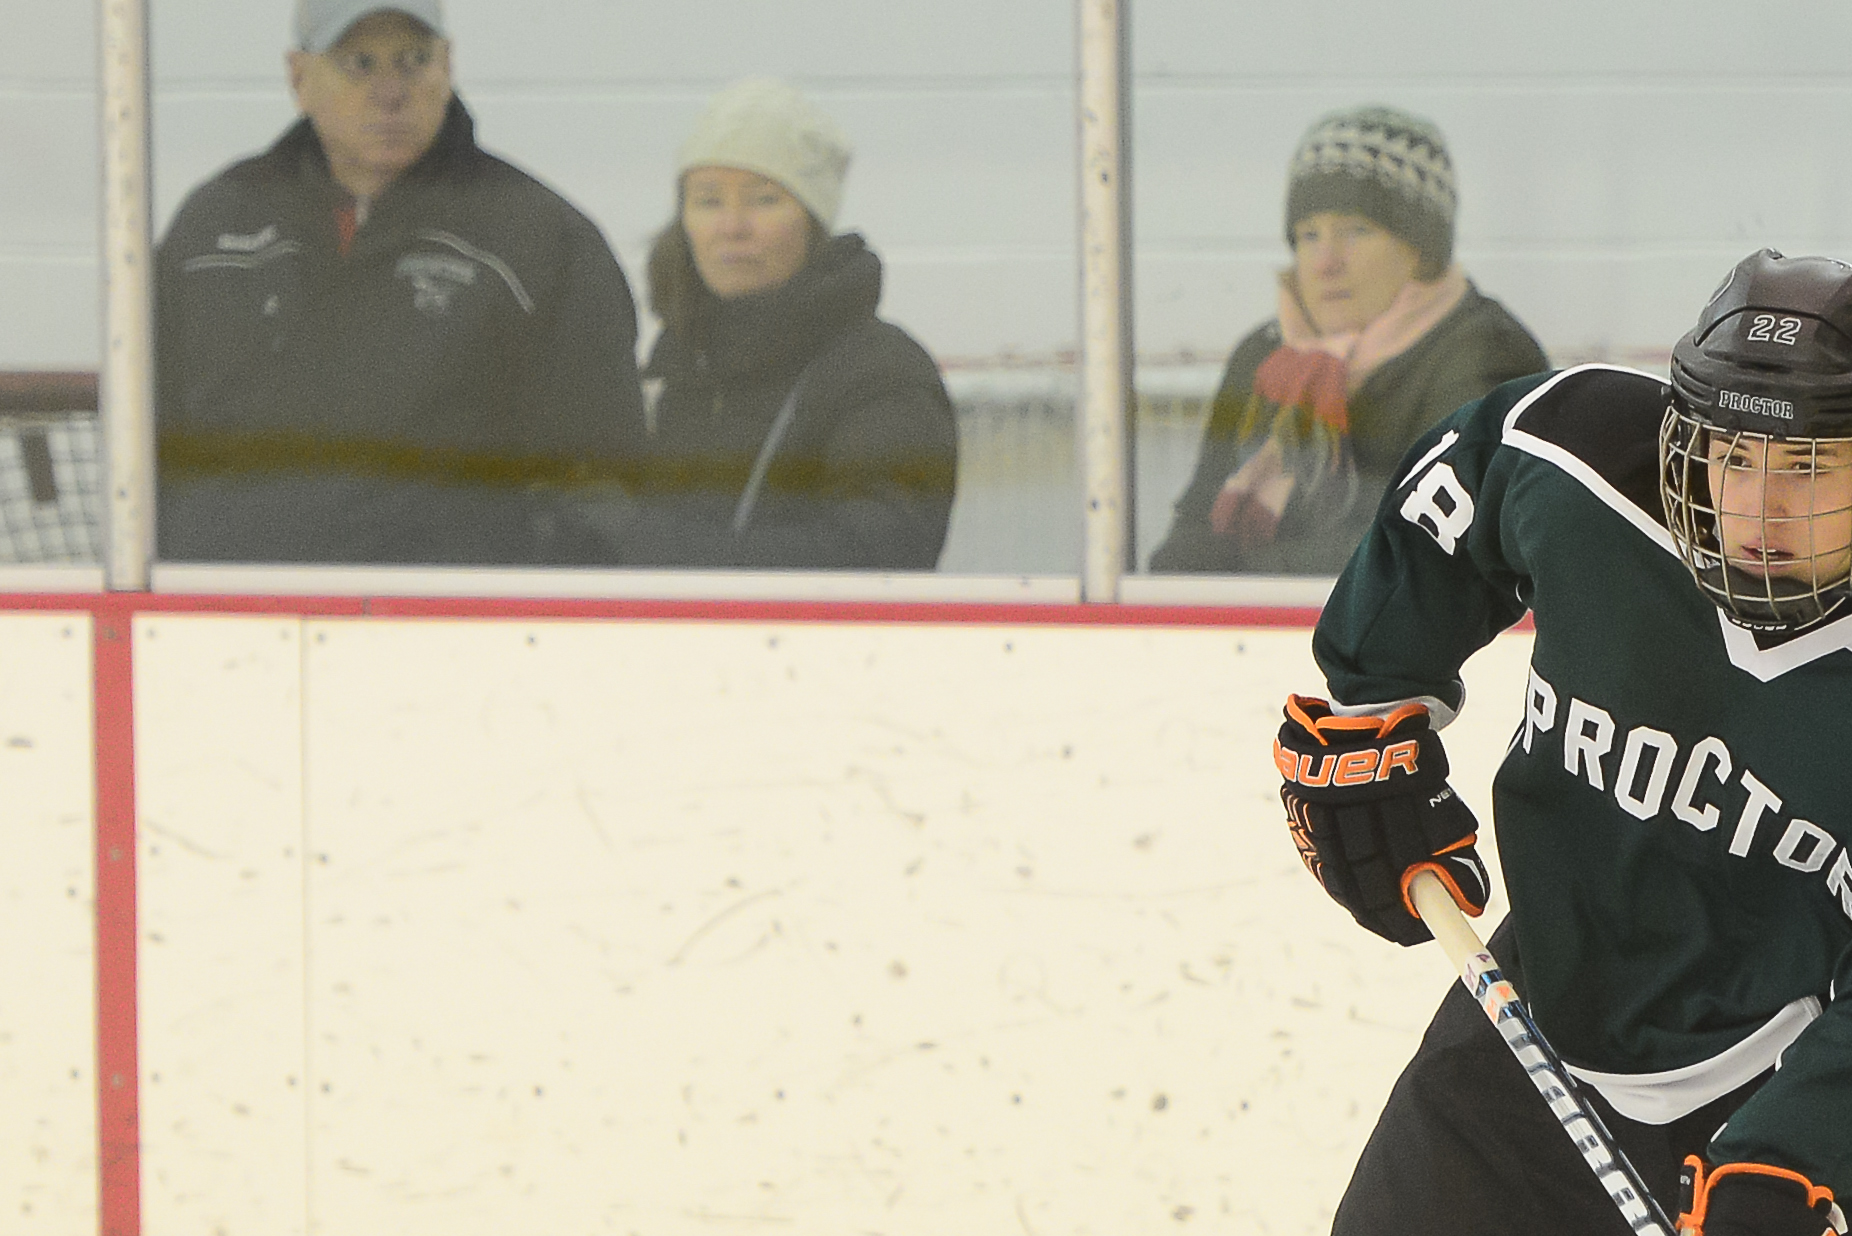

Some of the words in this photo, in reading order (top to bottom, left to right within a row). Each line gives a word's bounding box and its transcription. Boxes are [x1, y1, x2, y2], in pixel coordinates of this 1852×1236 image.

[1747, 314, 1801, 346] 22
[1718, 389, 1794, 420] PROCTOR
[1272, 738, 1420, 788] AUER
